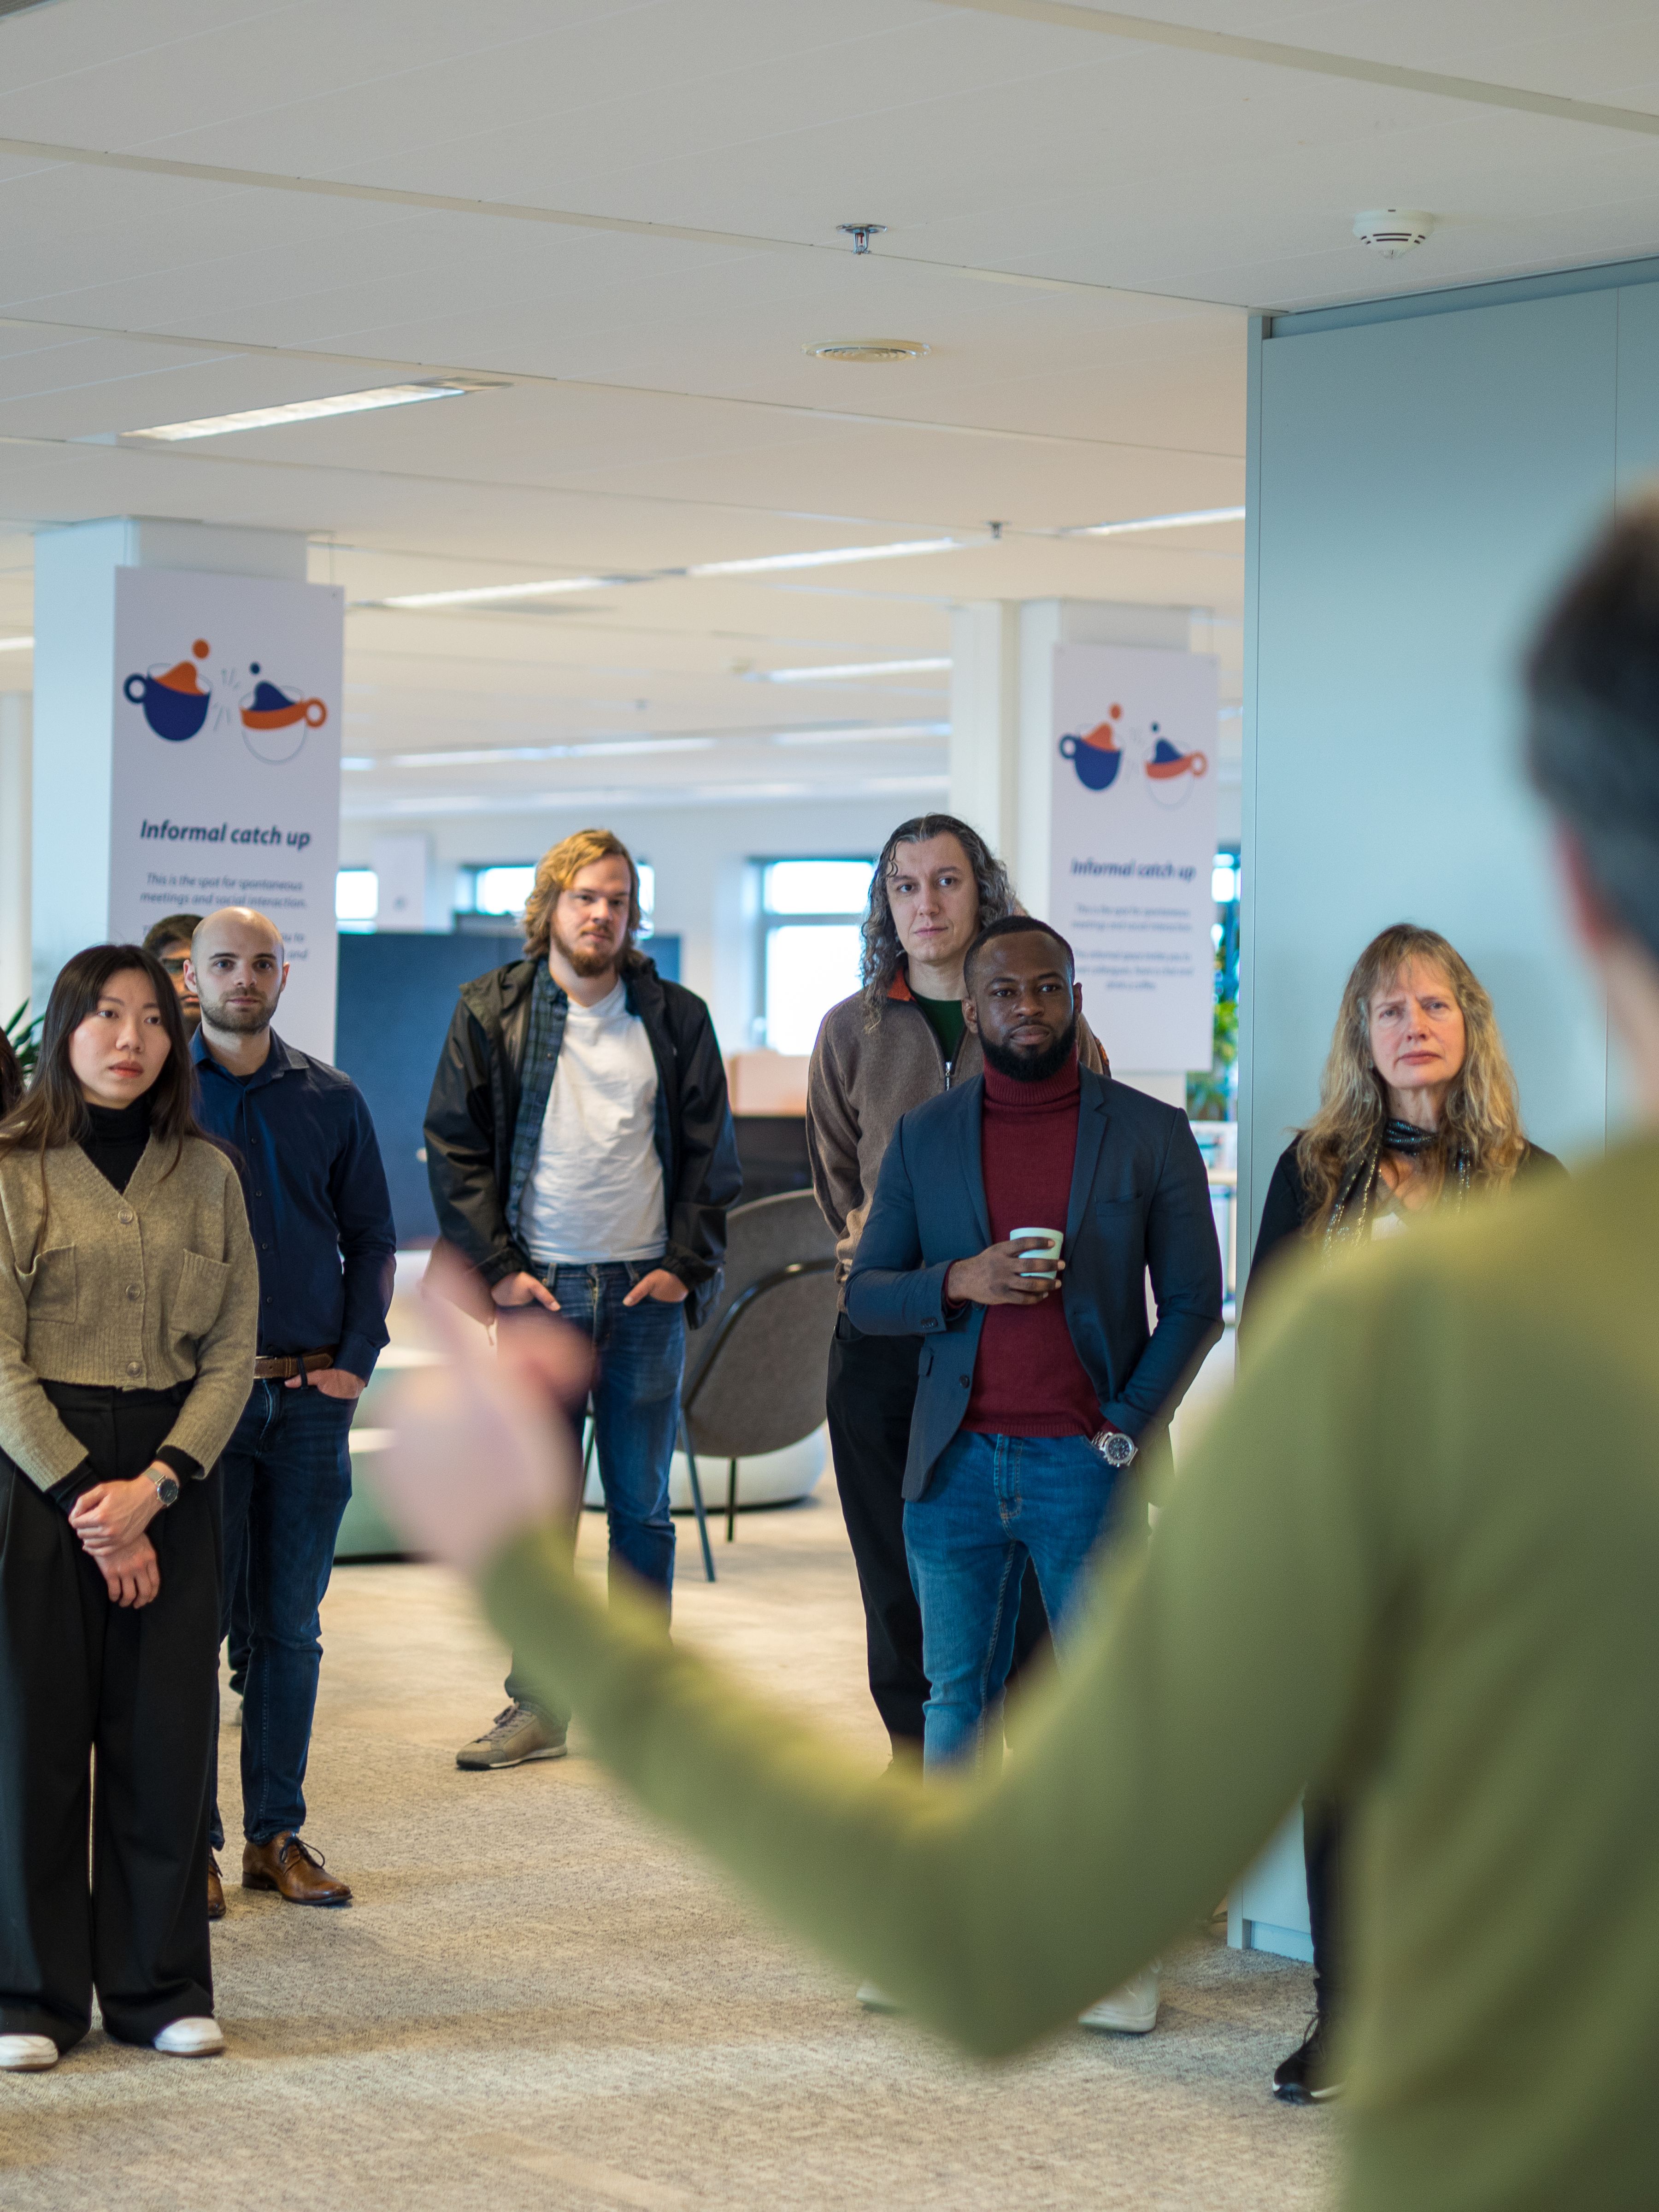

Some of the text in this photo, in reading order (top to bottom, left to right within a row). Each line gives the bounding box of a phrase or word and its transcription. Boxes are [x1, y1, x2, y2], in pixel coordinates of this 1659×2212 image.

[141, 819, 311, 852] Informal catch up
[1070, 857, 1136, 877] Informal
